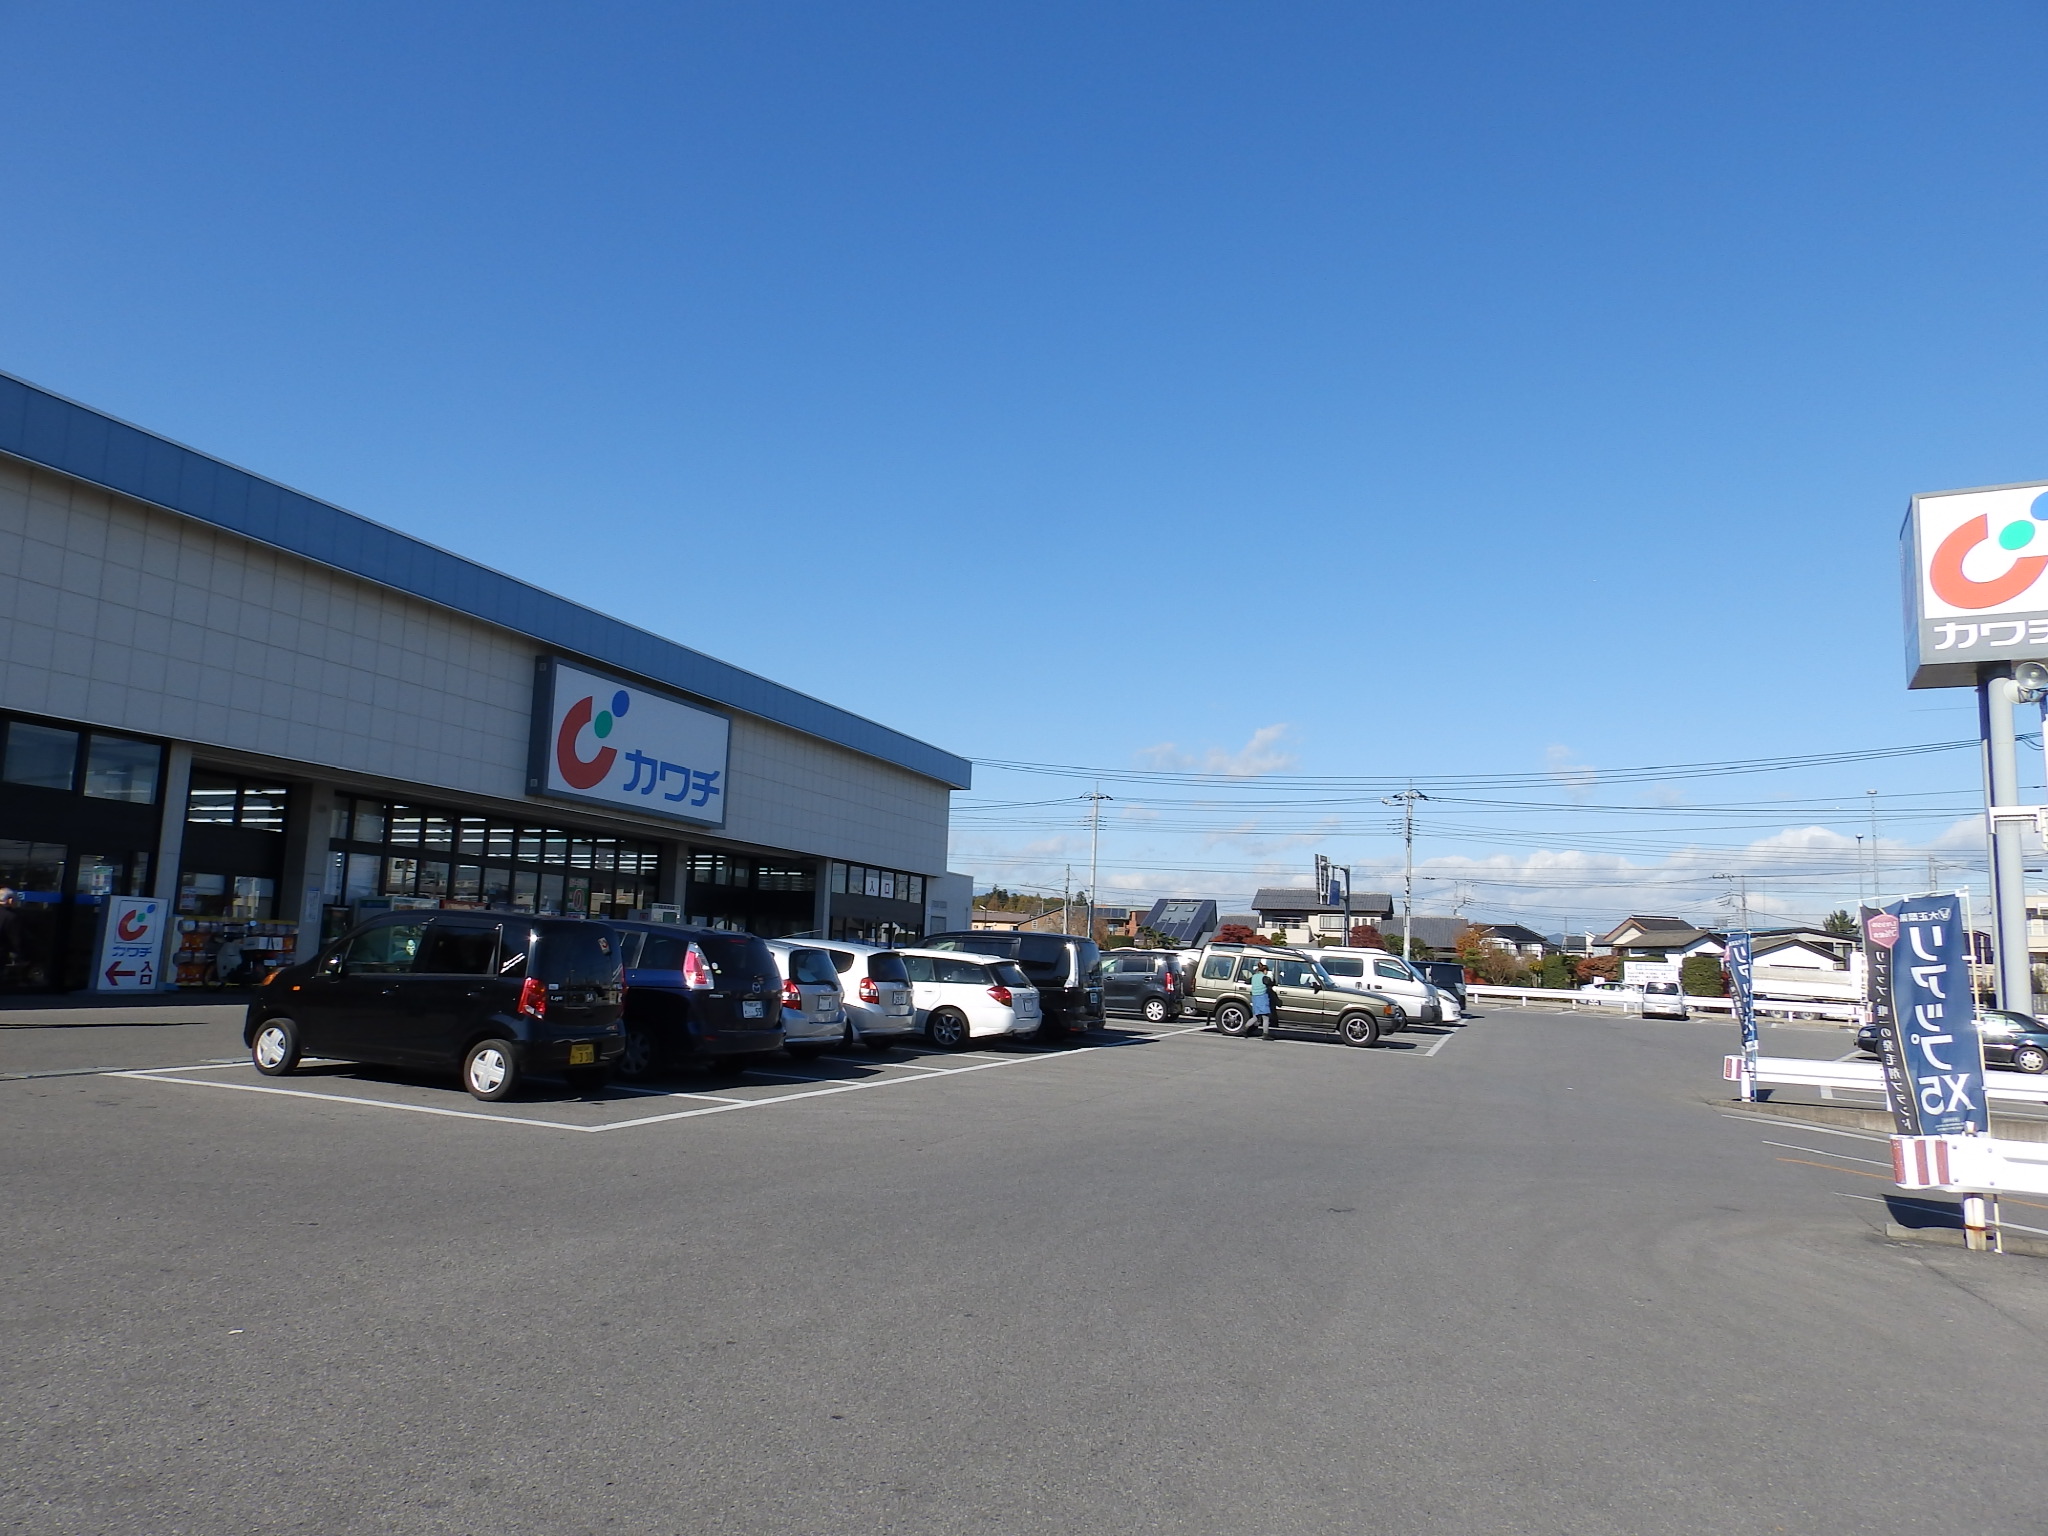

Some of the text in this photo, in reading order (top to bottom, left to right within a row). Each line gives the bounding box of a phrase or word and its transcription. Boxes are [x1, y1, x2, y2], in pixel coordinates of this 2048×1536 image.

[623, 749, 720, 807] カワチ
[112, 946, 152, 957] カワチ
[140, 961, 153, 985] 入口
